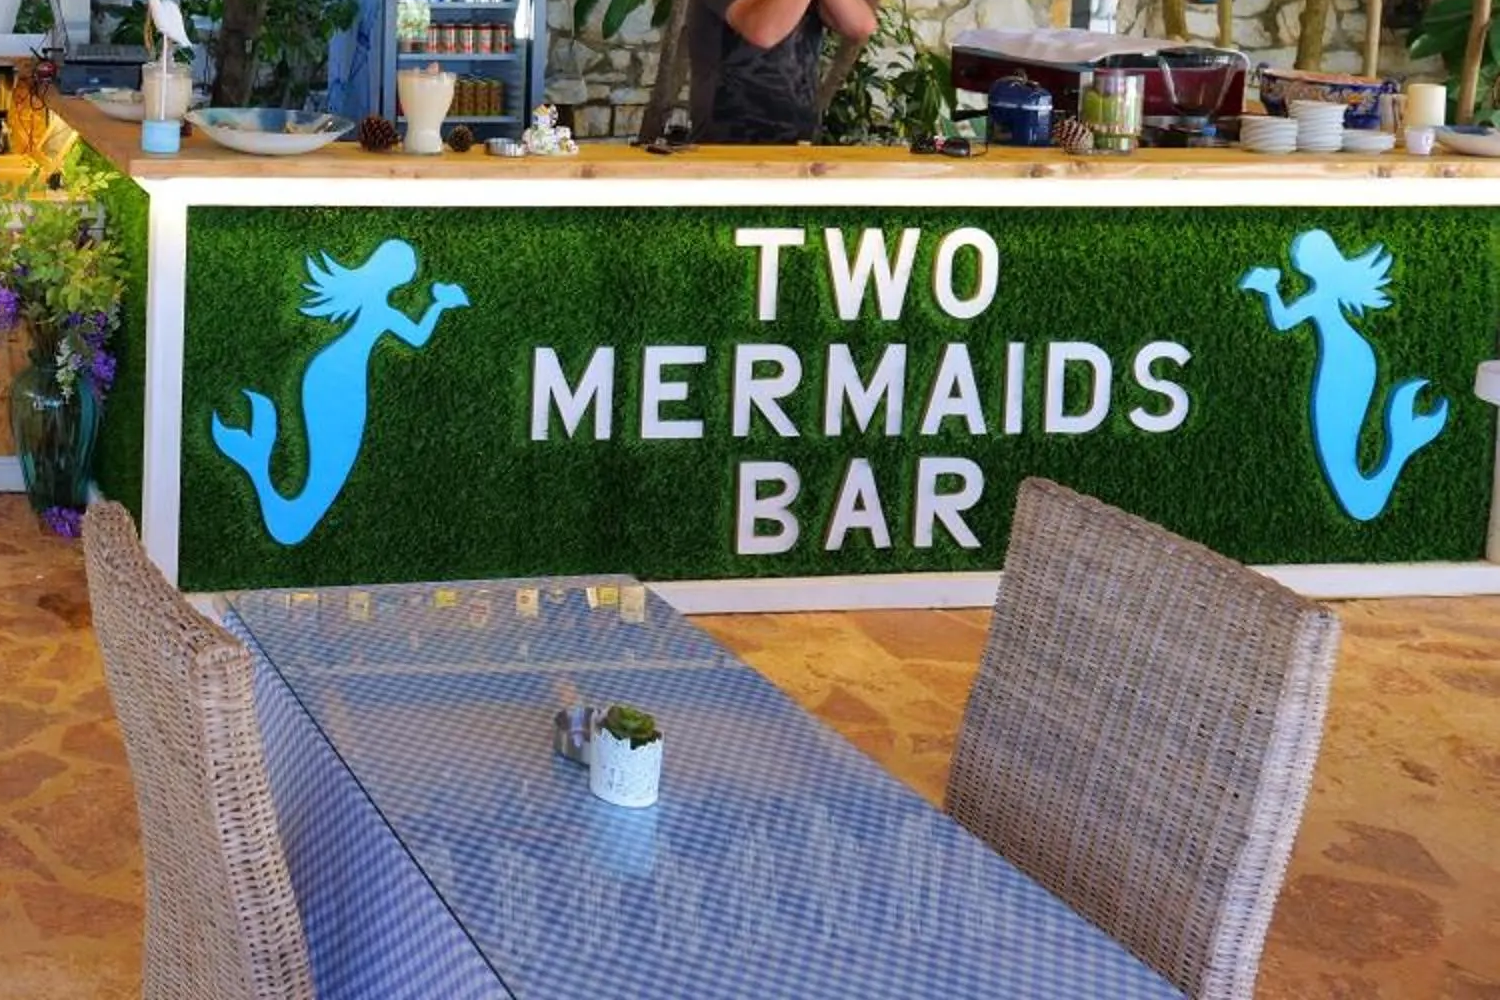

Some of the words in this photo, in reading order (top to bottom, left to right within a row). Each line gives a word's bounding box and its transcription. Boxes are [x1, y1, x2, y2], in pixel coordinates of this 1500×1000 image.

[734, 227, 1000, 321] TWO
[530, 341, 1192, 441] MERMAIDS
[736, 457, 986, 555] BAR
